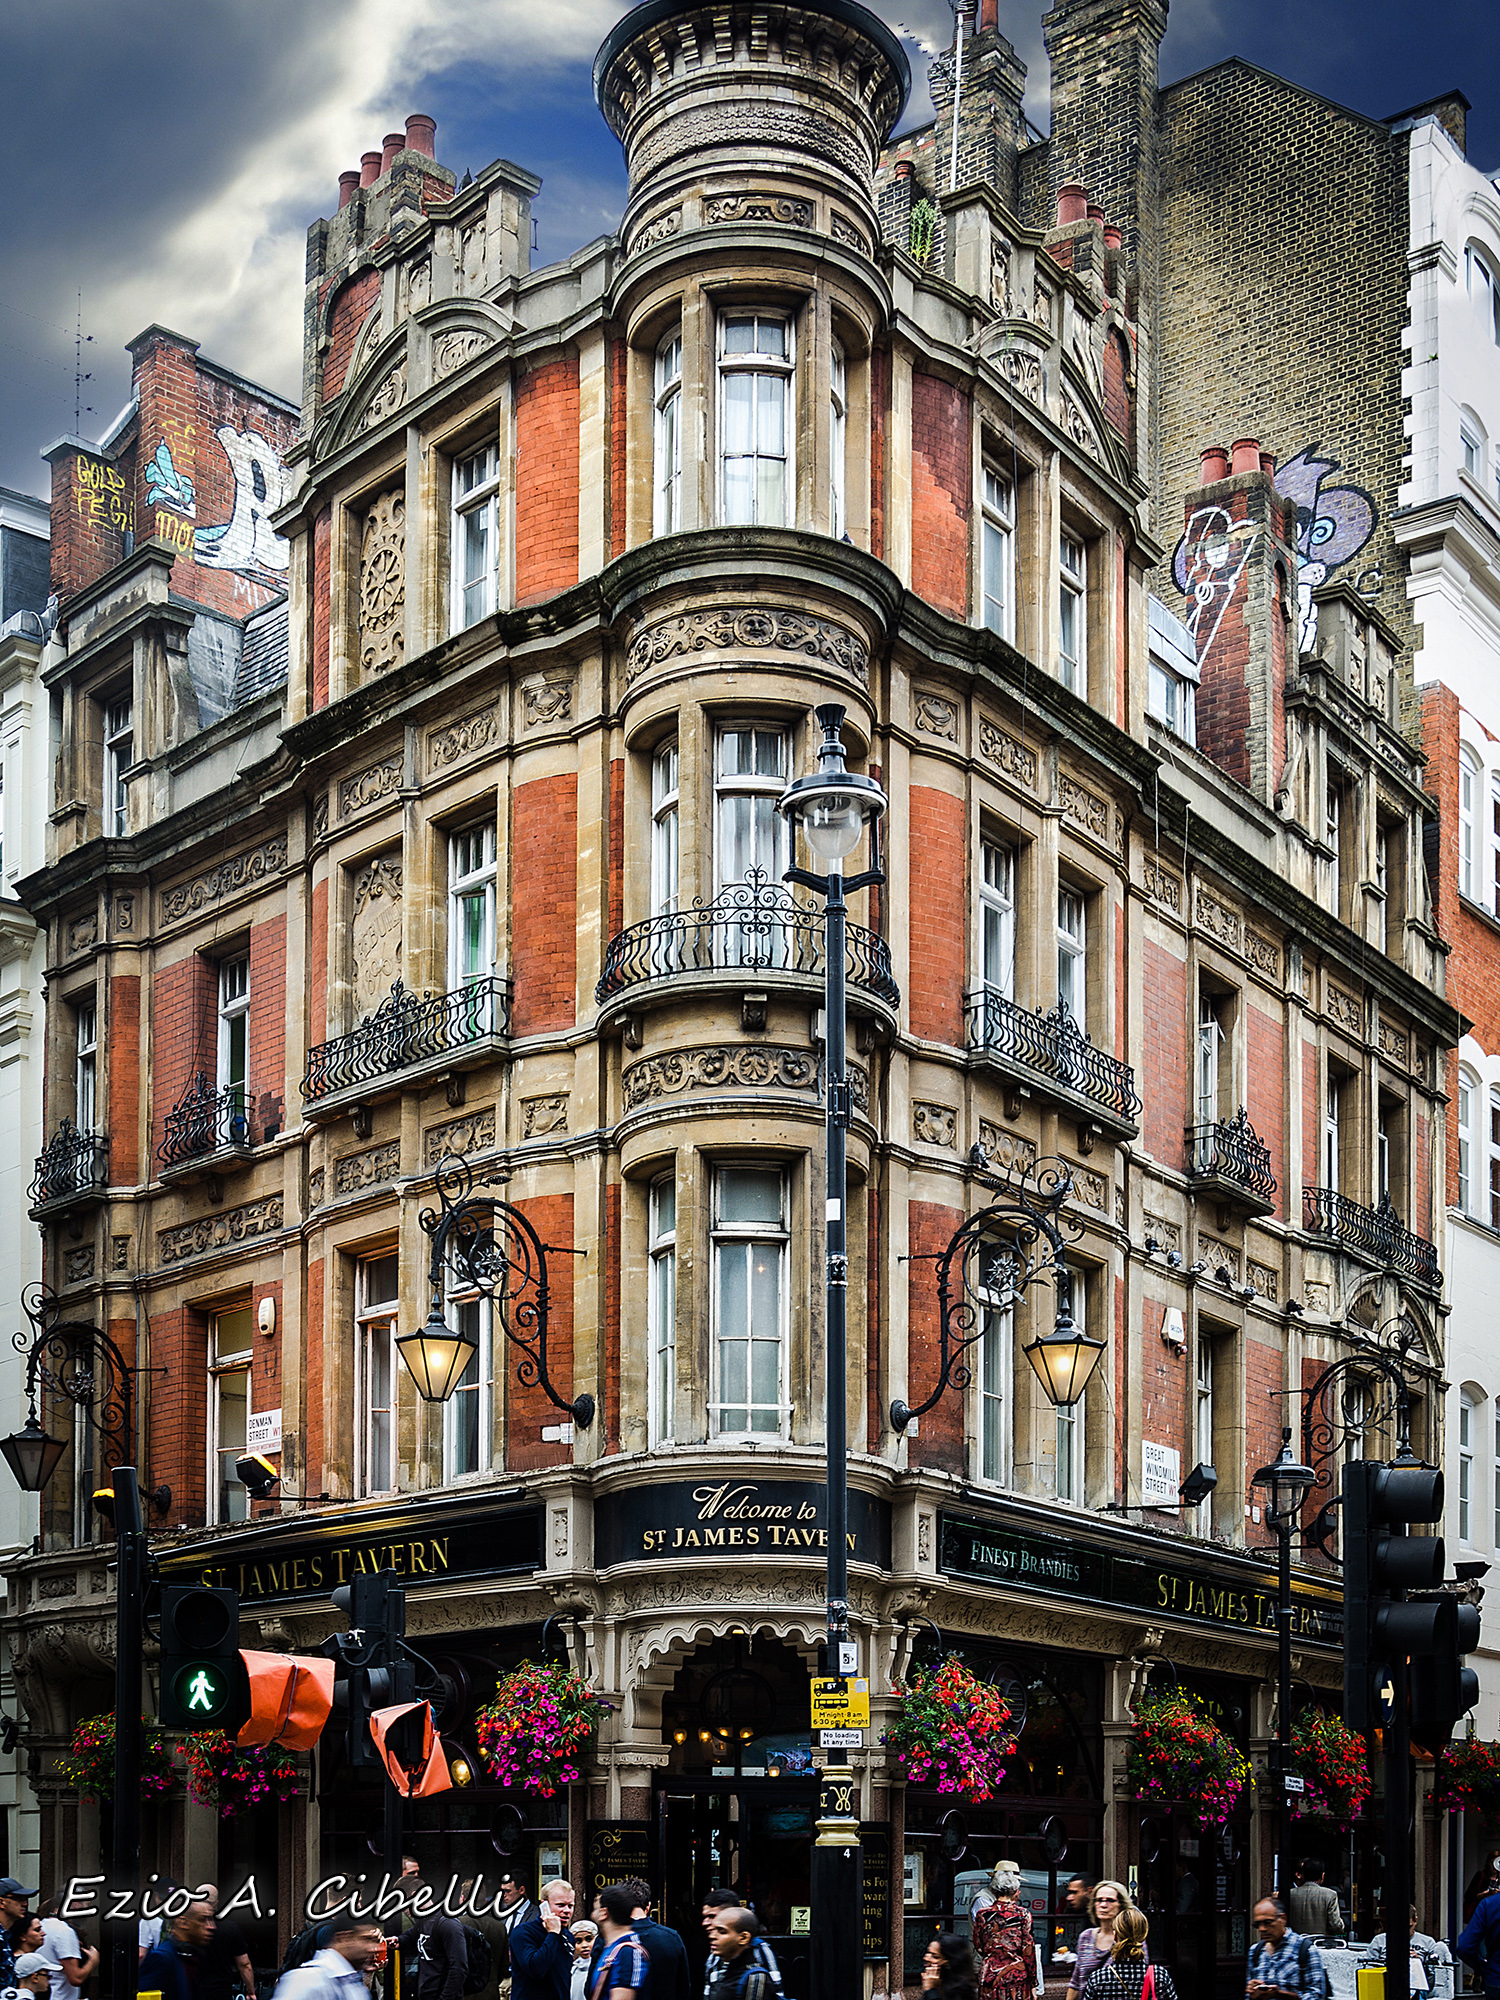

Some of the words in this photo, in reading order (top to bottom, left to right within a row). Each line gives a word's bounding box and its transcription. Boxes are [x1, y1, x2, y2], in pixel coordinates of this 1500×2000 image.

[77, 455, 125, 494] GOLD
[249, 1416, 272, 1429] DENMAN
[249, 1428, 268, 1442] STREET
[272, 1427, 280, 1437] W1
[1146, 1446, 1164, 1463] GREAT
[1146, 1462, 1176, 1482] WINDMILL
[1146, 1477, 1166, 1494] STREET
[1168, 1484, 1177, 1498] W1
[692, 1481, 791, 1520] Welcome
[797, 1500, 817, 1520] to
[671, 1526, 759, 1548] JAMES
[768, 1525, 857, 1551] TAVEN
[239, 1556, 323, 1597] JAMES
[331, 1537, 449, 1584] TAVERN
[971, 1540, 1017, 1569] FINEST
[1020, 1550, 1080, 1582] BRANDIES
[1185, 1579, 1249, 1623] JAMES
[1254, 1594, 1322, 1636] TAERN
[844, 1848, 851, 1858] 4
